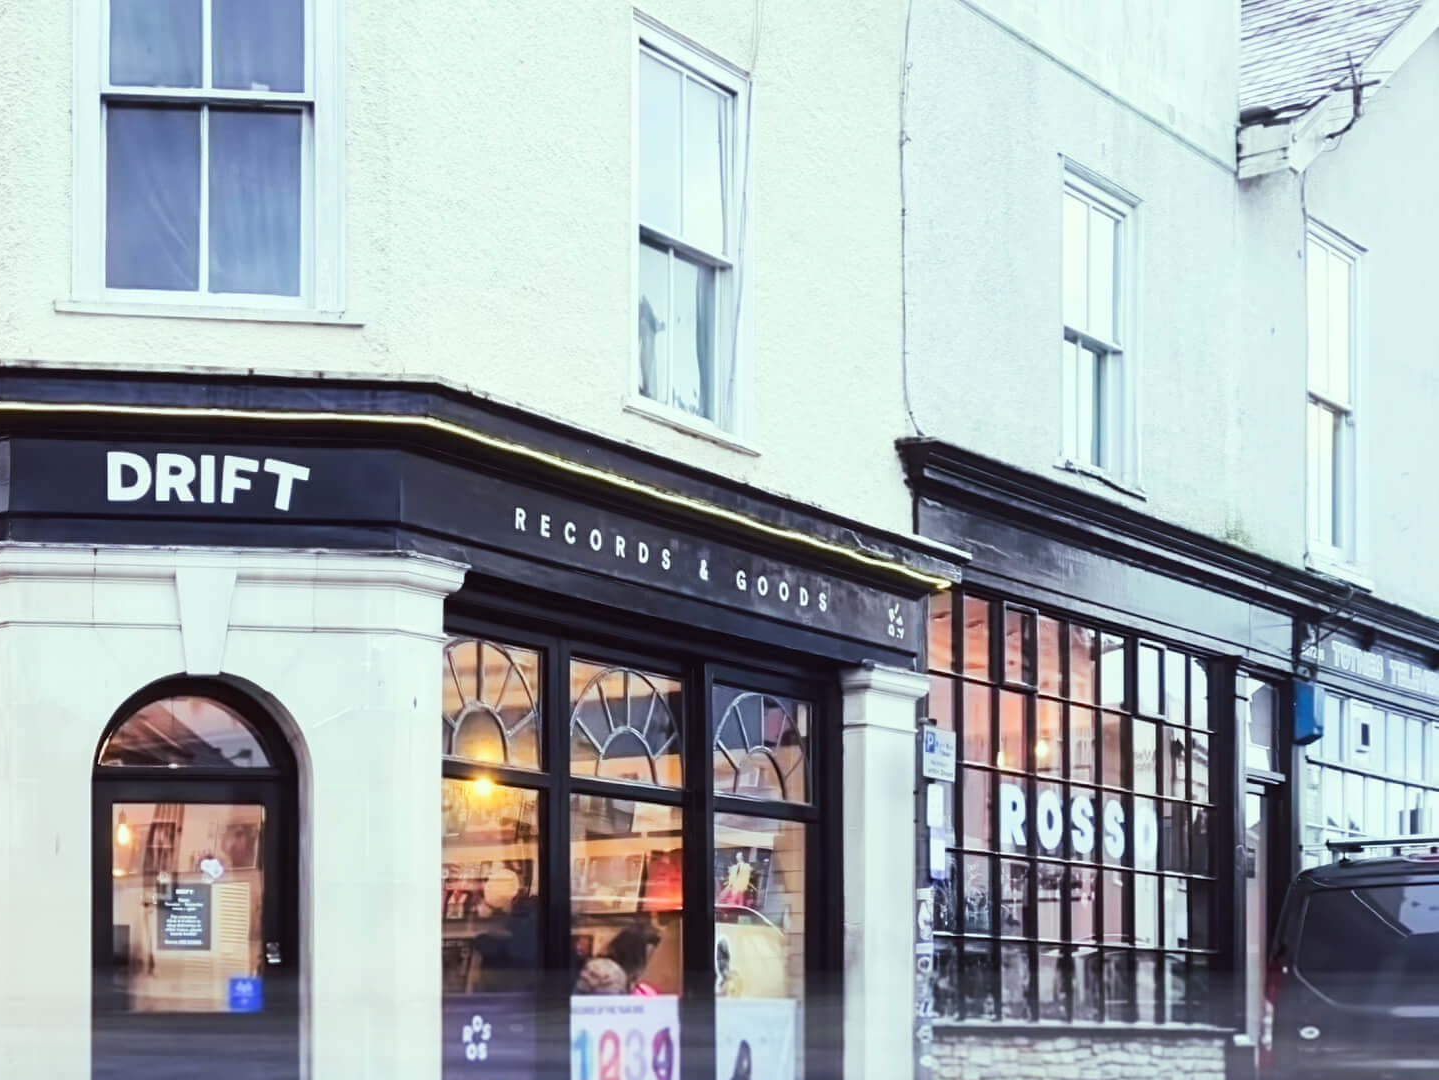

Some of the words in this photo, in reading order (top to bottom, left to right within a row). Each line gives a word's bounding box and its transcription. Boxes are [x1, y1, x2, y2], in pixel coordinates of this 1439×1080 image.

[107, 451, 310, 511] DRIFT
[515, 507, 671, 570] RECORDS
[699, 559, 709, 580] &
[736, 570, 828, 612] GOODS
[999, 783, 1158, 861] ROSSO
